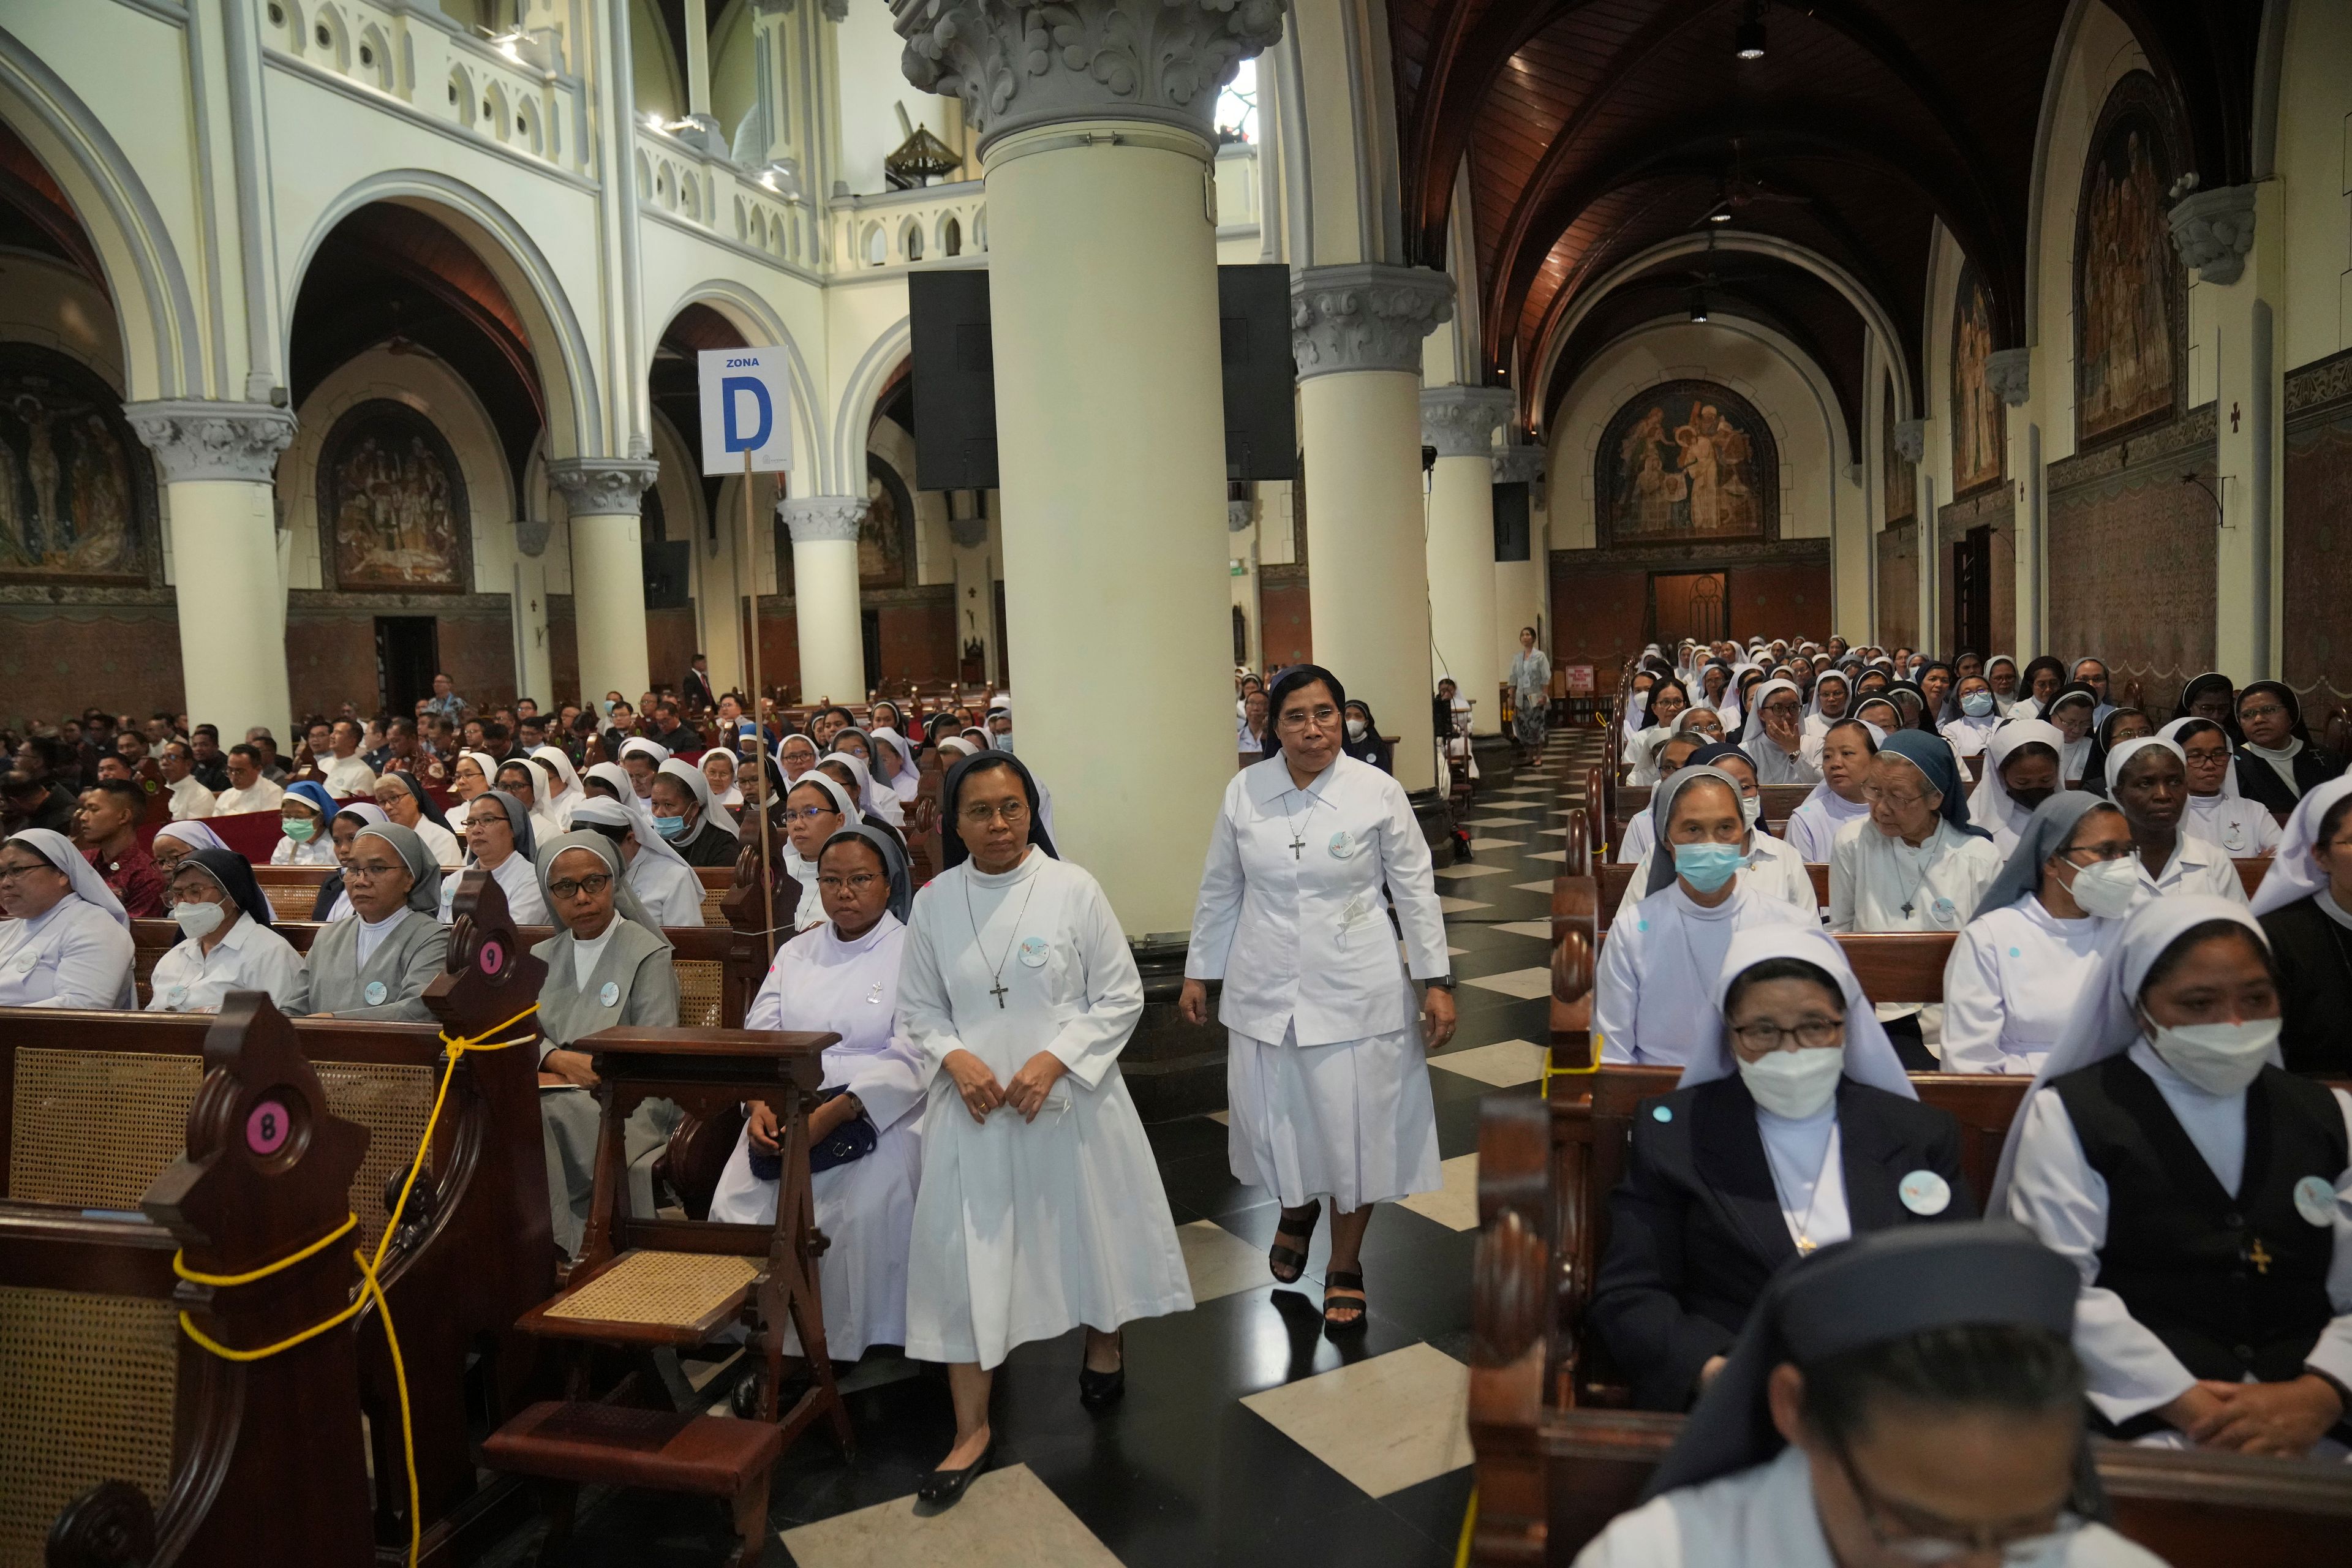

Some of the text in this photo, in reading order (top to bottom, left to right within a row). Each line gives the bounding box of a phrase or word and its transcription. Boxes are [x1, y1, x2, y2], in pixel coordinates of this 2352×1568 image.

[726, 358, 760, 368] ZONA
[722, 377, 773, 453] D
[486, 948, 495, 967] 9
[261, 1113, 276, 1140] 8
